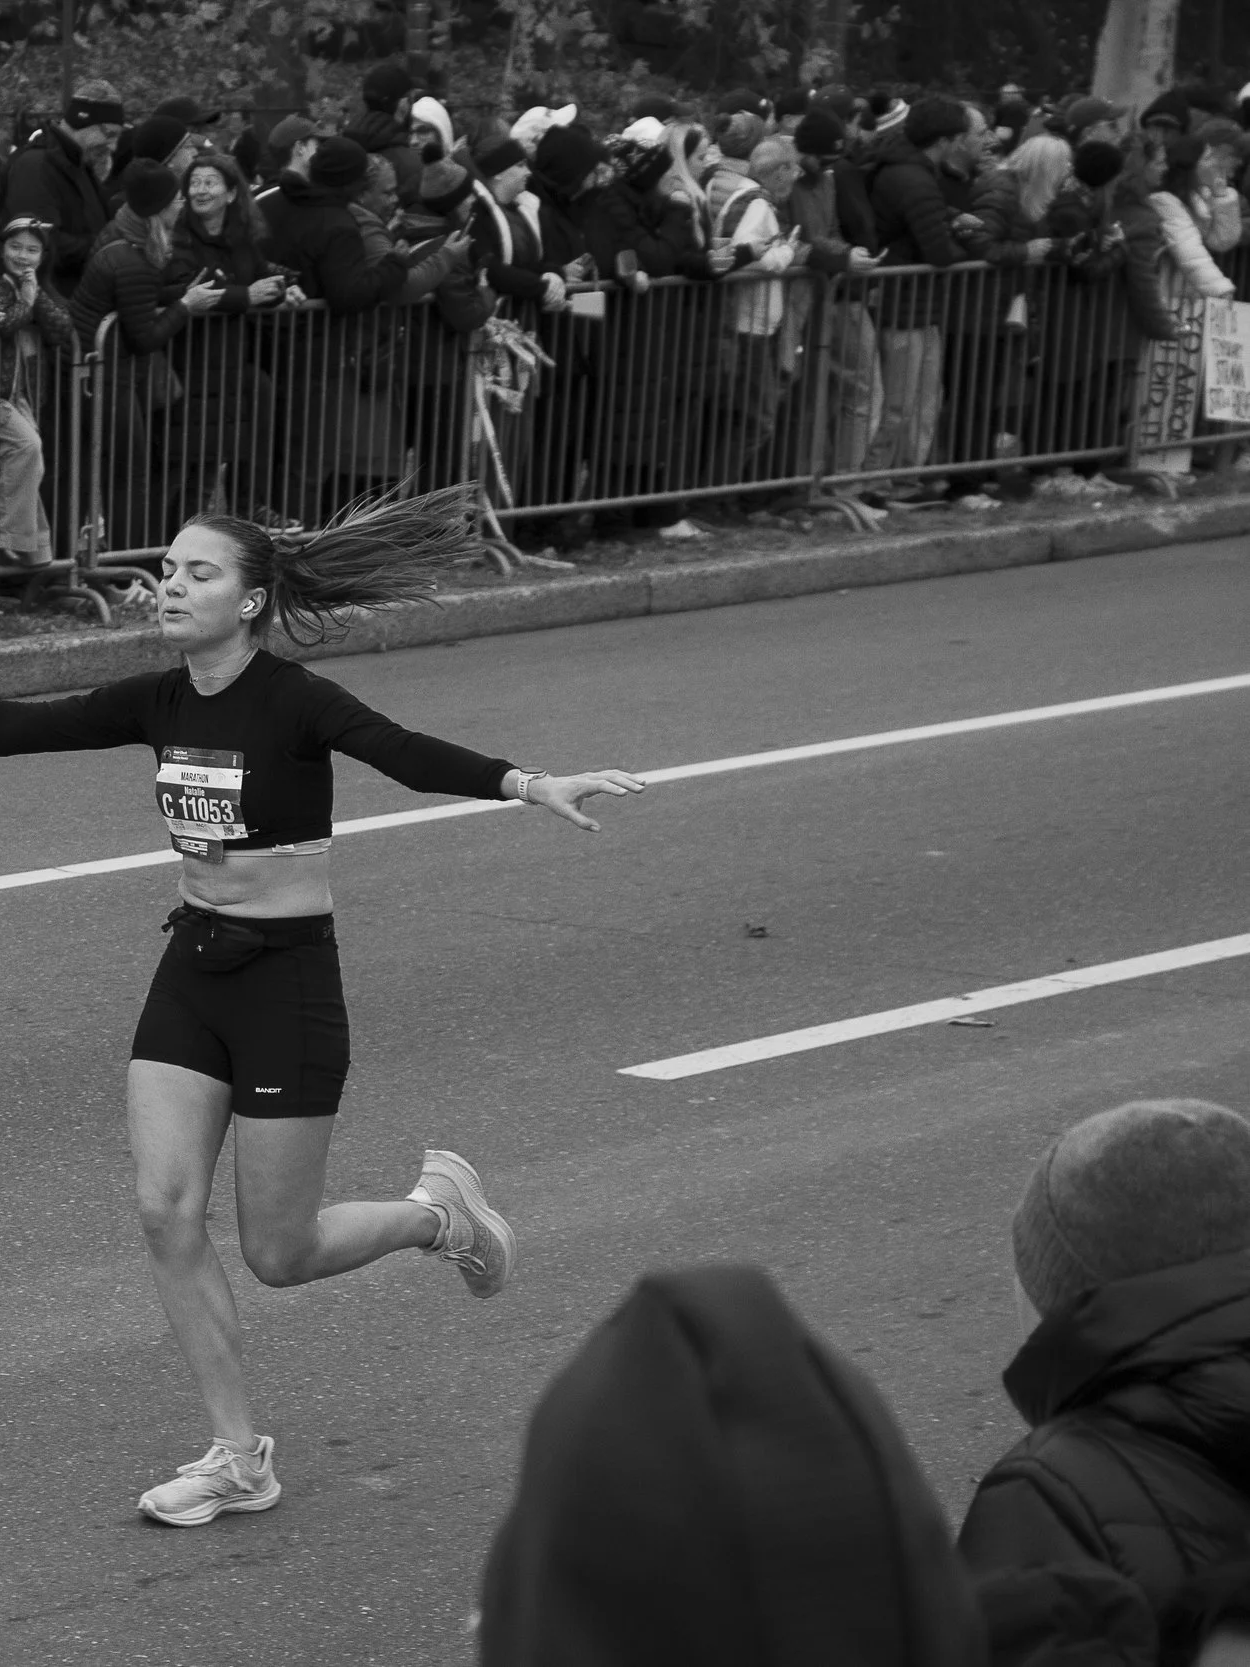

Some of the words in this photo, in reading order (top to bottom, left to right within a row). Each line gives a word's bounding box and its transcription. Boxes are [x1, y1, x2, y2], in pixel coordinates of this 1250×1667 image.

[181, 771, 209, 784] MARATHON
[184, 786, 206, 797] Natalie
[162, 793, 175, 818] C
[178, 795, 235, 823] 11053
